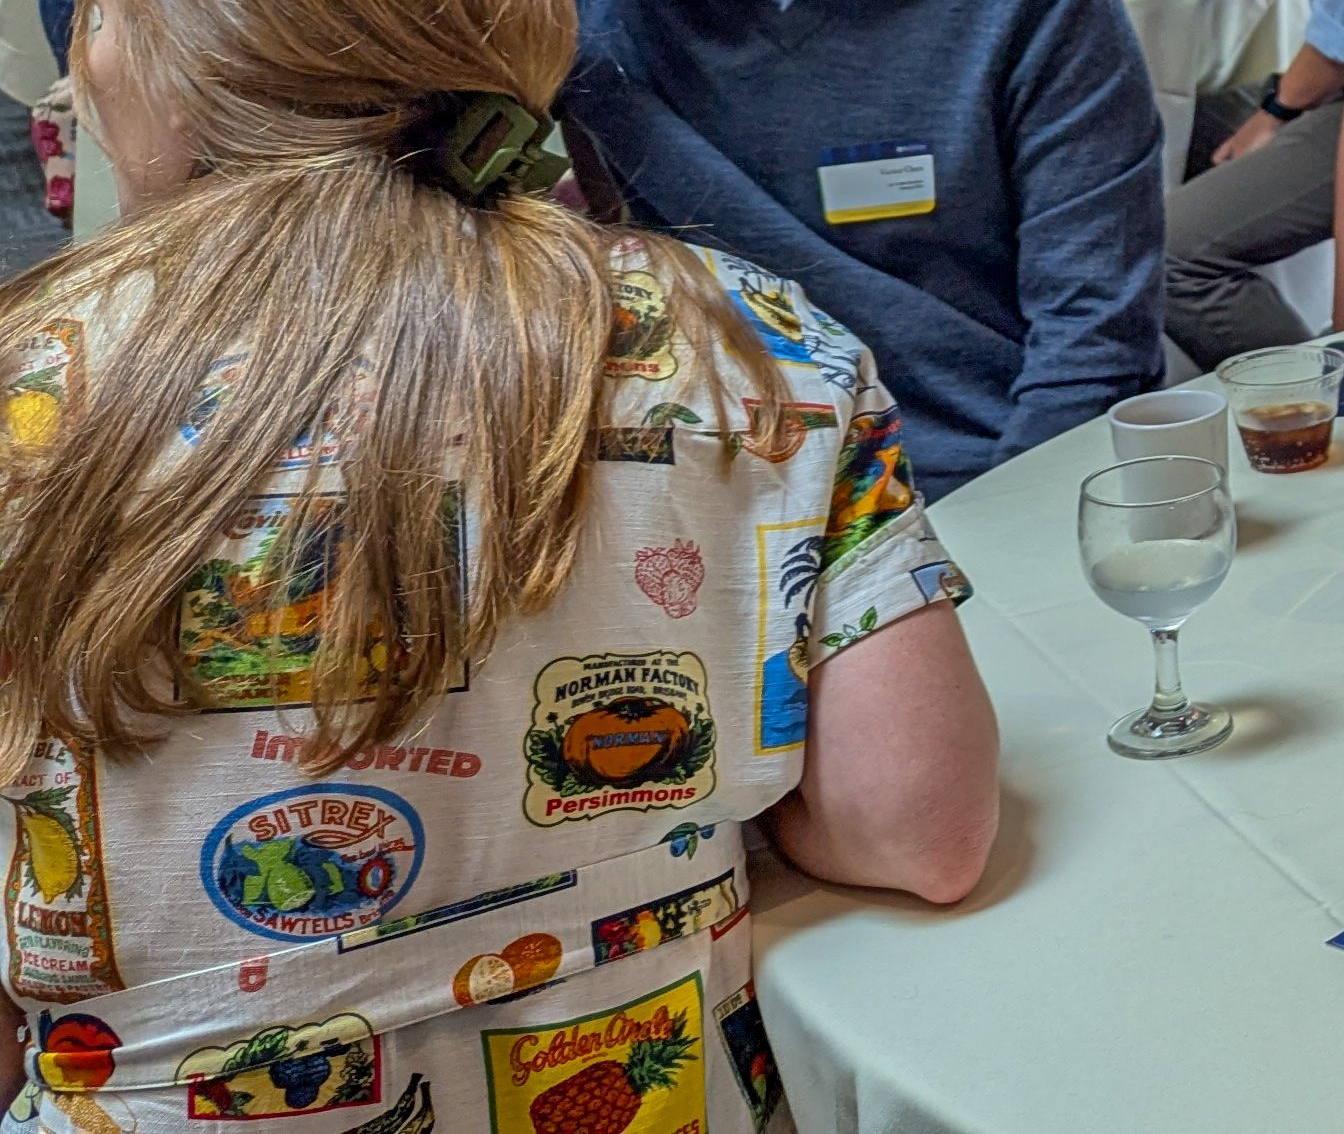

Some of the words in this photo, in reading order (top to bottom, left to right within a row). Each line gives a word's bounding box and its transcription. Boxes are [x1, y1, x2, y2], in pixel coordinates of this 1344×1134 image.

[555, 668, 636, 703] NORMAN
[641, 668, 699, 696] FACTORY
[591, 730, 666, 750] NORMAN
[54, 771, 73, 785] OF
[546, 786, 698, 817] Persimmons
[248, 799, 397, 843] SITREX
[17, 900, 88, 938] LEMON
[510, 1025, 603, 1087] Golden
